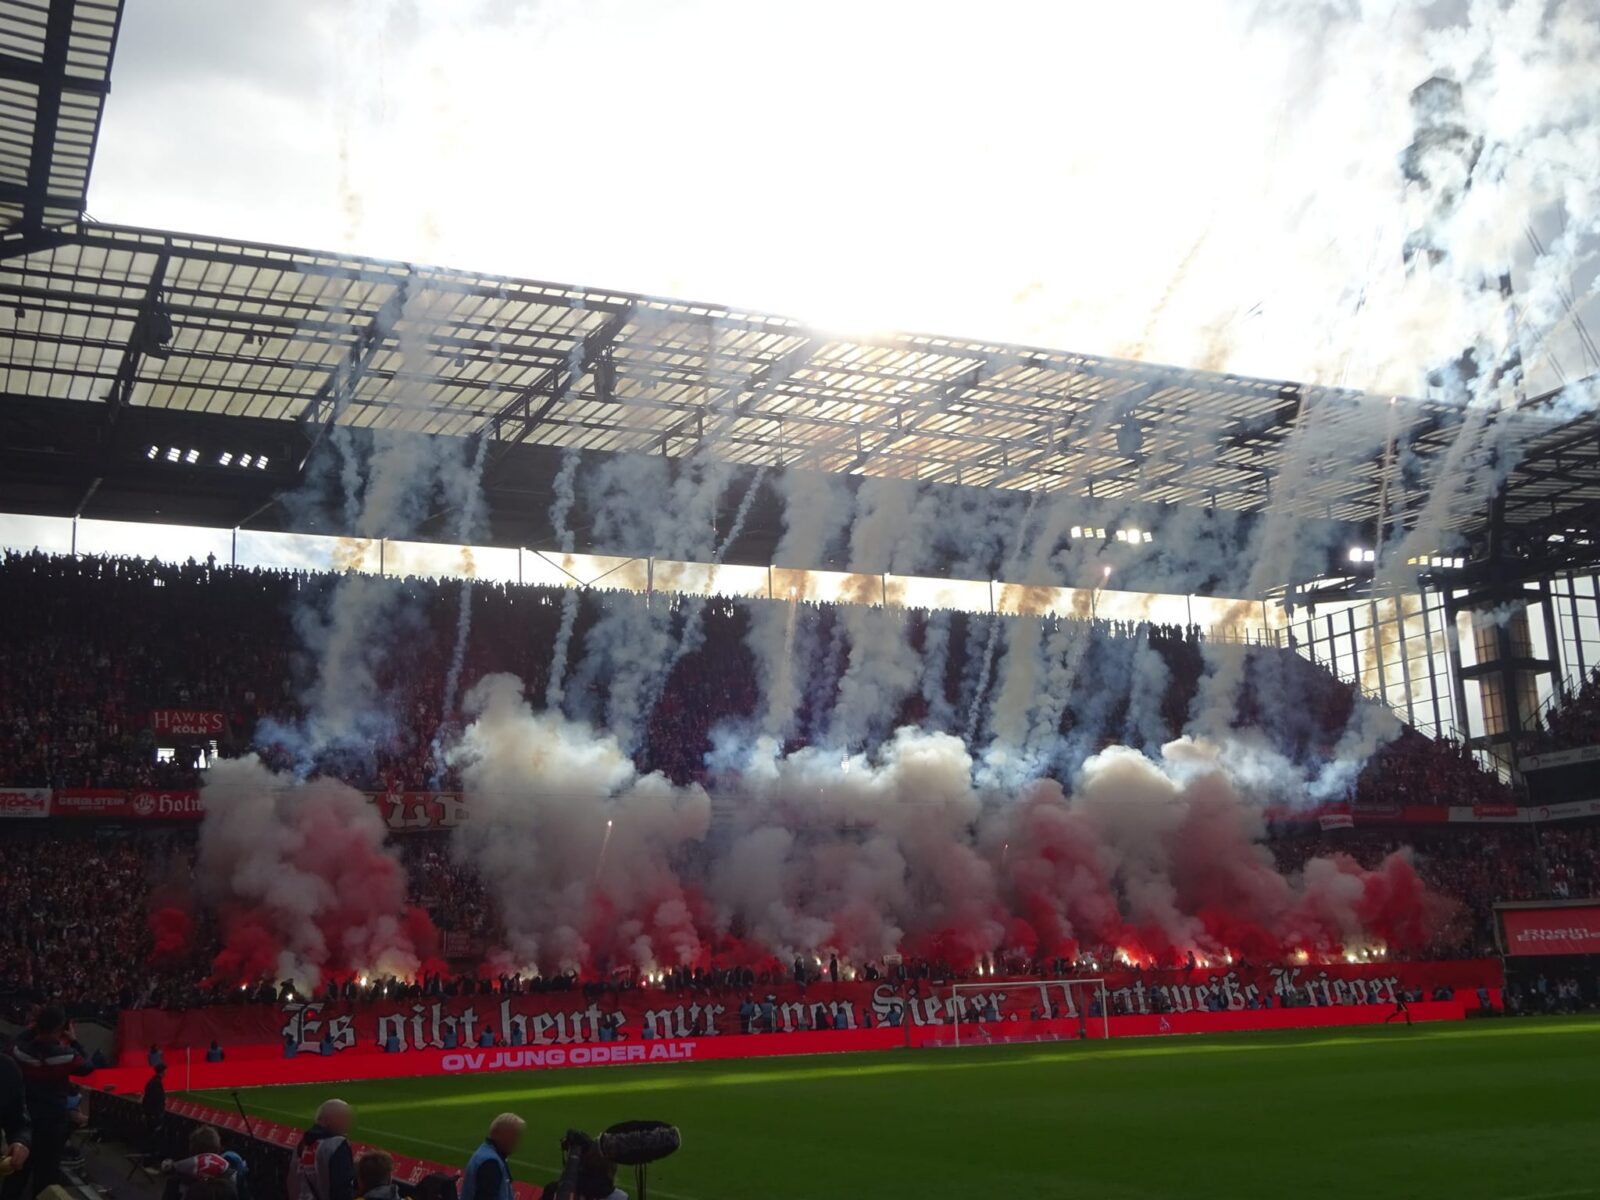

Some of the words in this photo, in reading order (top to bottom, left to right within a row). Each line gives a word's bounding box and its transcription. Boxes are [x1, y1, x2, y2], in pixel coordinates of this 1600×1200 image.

[154, 711, 224, 730] HAWKS
[172, 724, 207, 734] KÖLN
[282, 1002, 356, 1054] Es
[377, 1002, 479, 1054] gibt
[500, 998, 627, 1045] heute
[644, 1001, 726, 1040] nur
[1270, 968, 1398, 1007] Krieger
[441, 1053, 485, 1071] OV
[489, 1048, 565, 1069] JUNG
[569, 1044, 646, 1063] ODER
[649, 1042, 697, 1059] ALT
